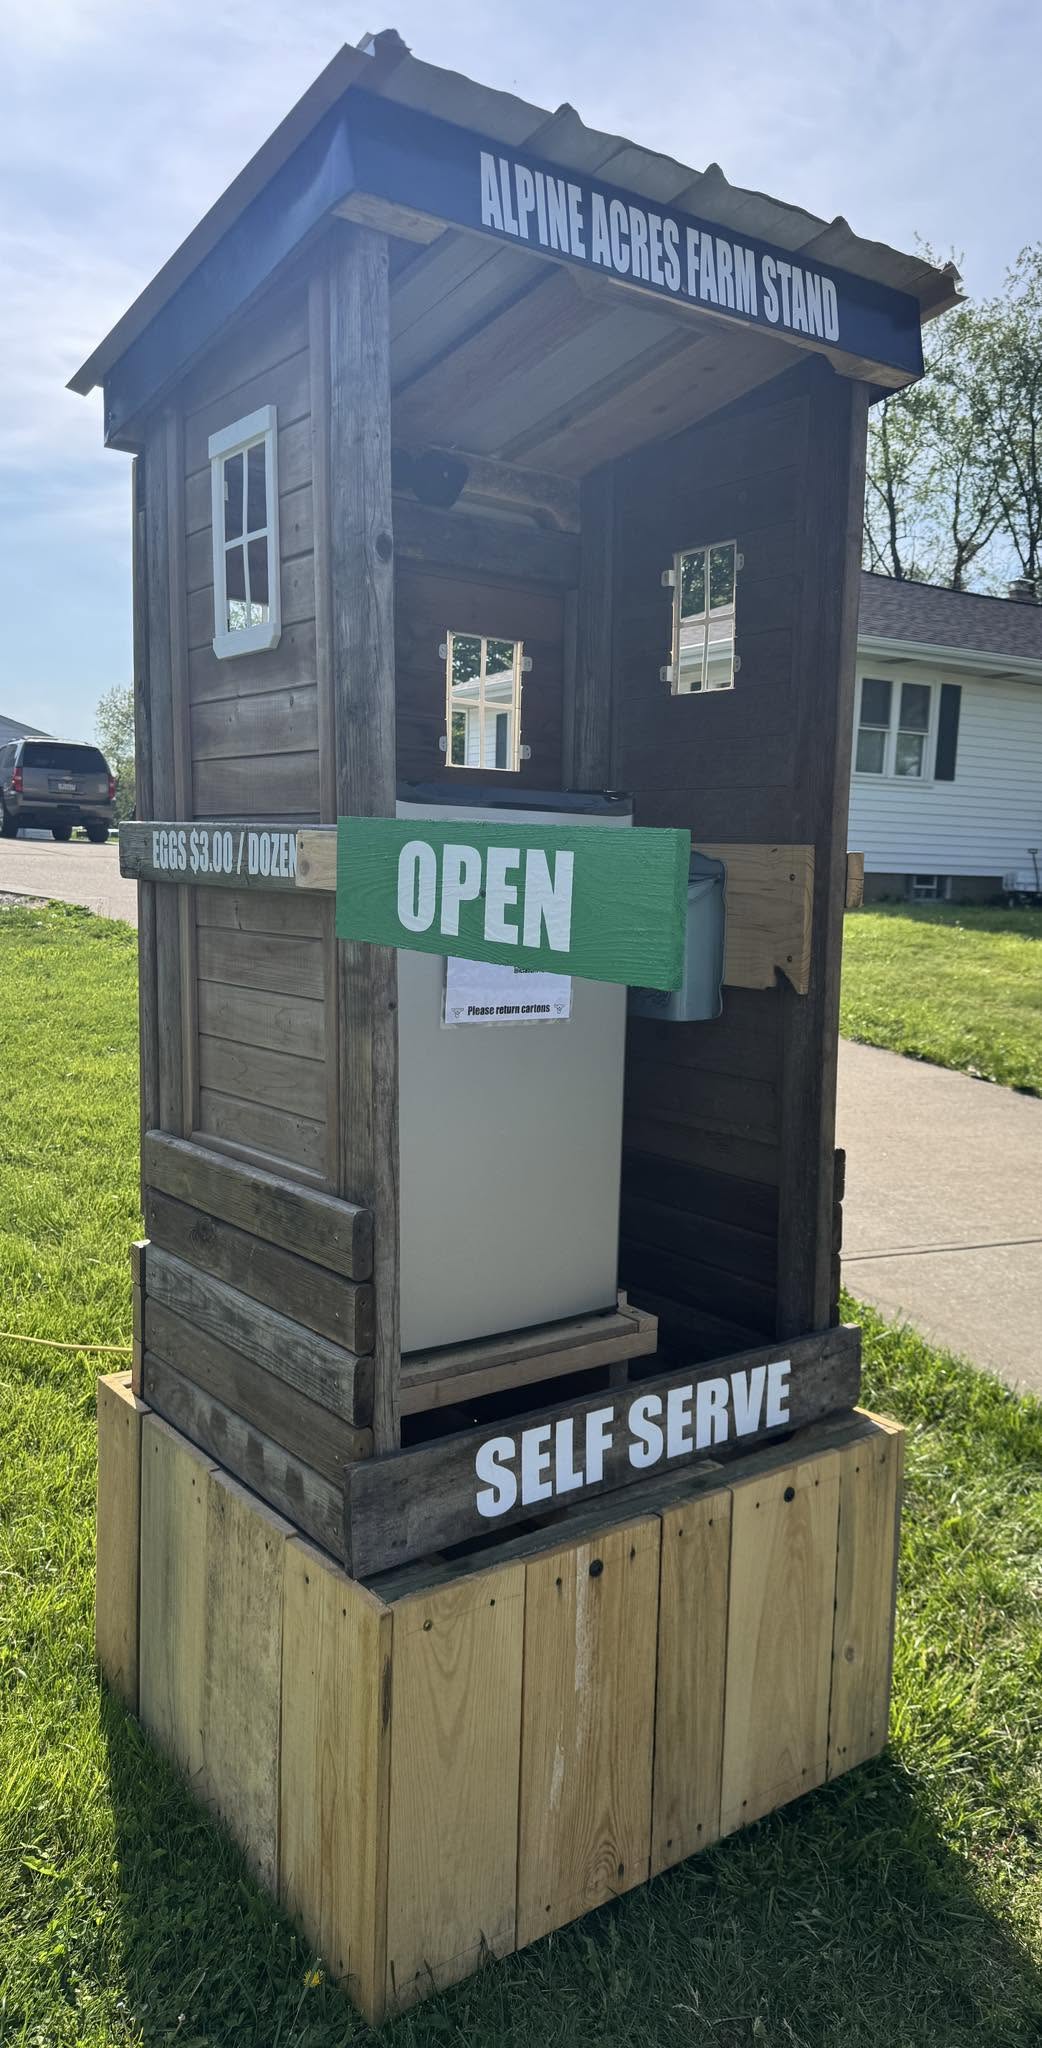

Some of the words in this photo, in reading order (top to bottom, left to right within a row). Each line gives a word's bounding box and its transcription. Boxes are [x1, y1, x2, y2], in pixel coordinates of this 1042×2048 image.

[480, 151, 586, 259] ALPINE
[591, 192, 680, 292] ACRES
[686, 226, 757, 317] FARM
[762, 255, 840, 342] STAND
[152, 830, 187, 871] EGGS
[190, 828, 233, 875] $3.00
[236, 832, 245, 875] /
[248, 832, 297, 878] DOZEN
[397, 840, 574, 952] OPEN
[467, 1005, 495, 1016] Please
[496, 1005, 520, 1015] return
[521, 1004, 551, 1014] cartons
[475, 1406, 614, 1518] SELF
[628, 1359, 792, 1468] SERVE
